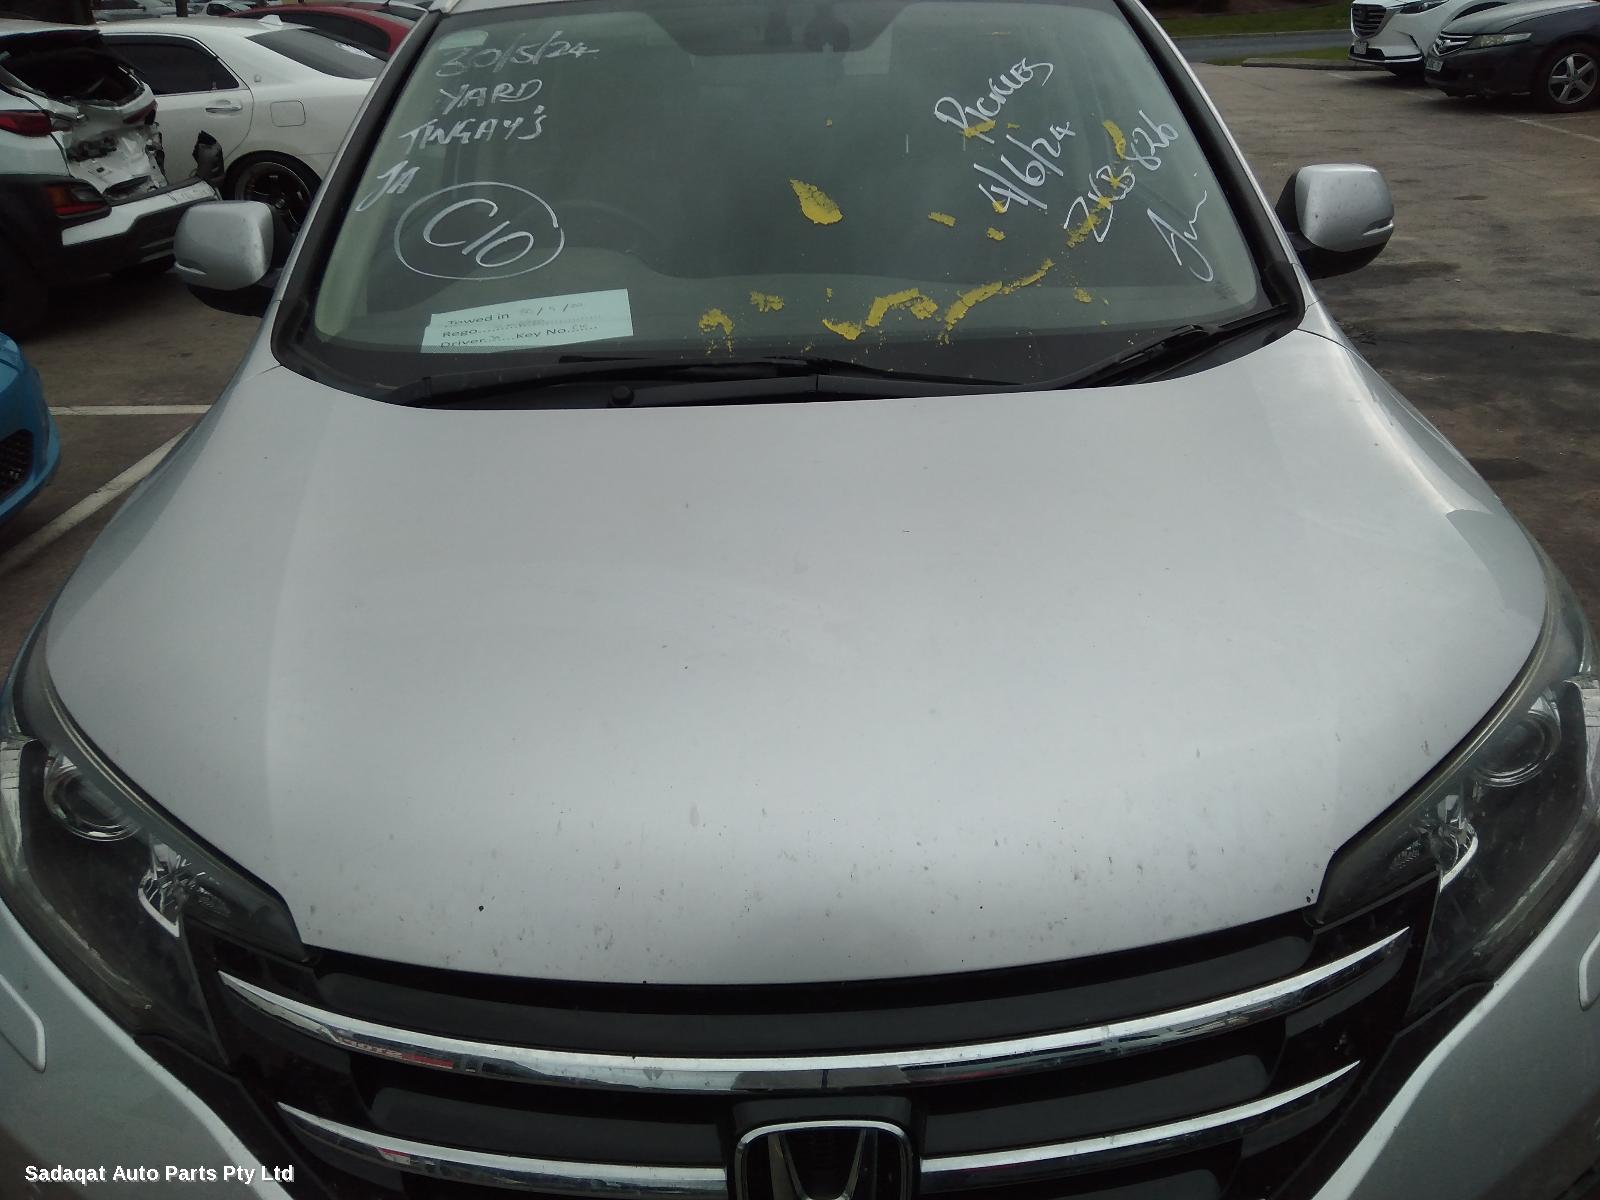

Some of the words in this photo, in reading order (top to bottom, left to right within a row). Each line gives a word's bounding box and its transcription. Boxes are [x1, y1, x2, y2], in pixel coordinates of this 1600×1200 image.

[439, 79, 543, 115] YARD
[973, 121, 1076, 213] 4/6/24
[447, 314, 493, 326] Towed
[496, 313, 510, 321] in
